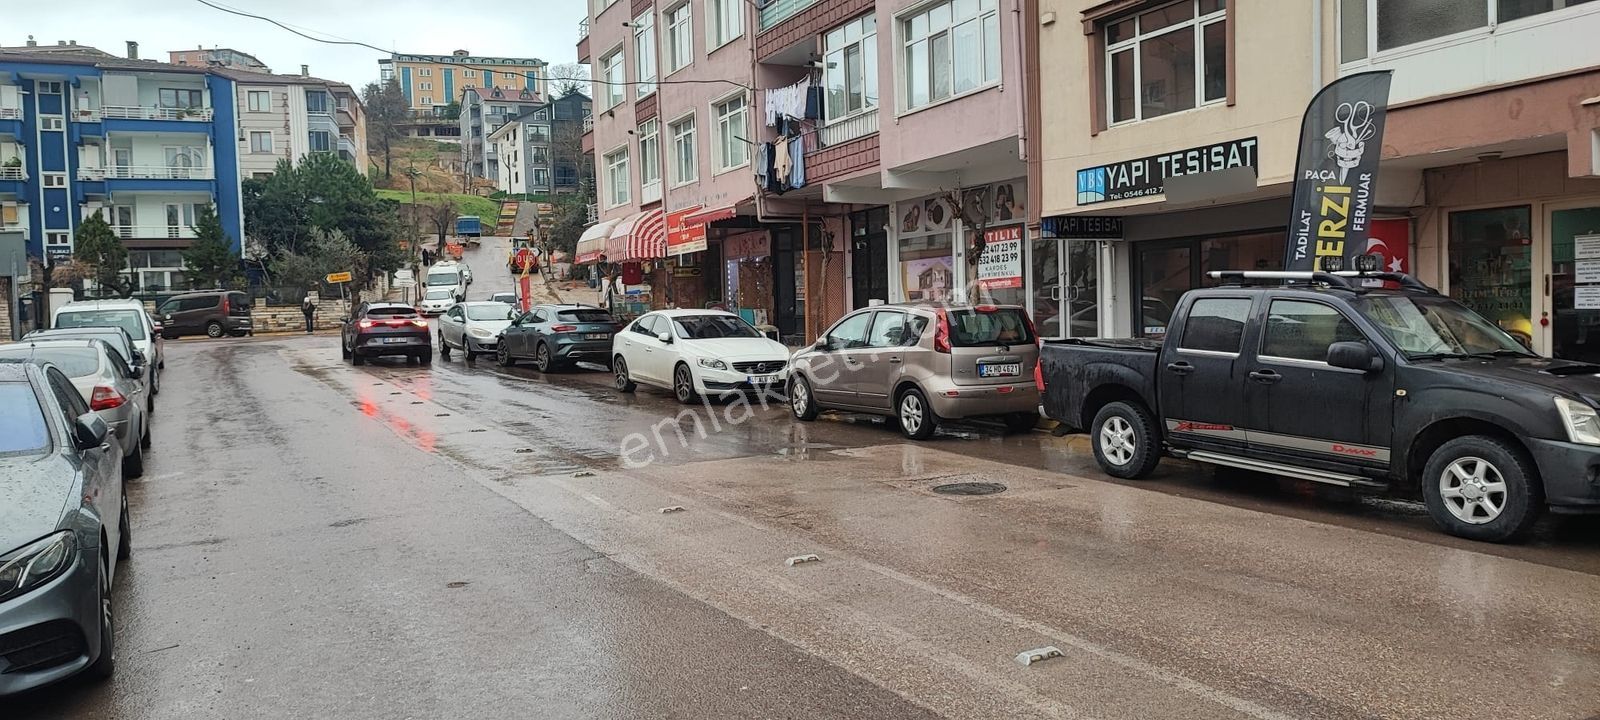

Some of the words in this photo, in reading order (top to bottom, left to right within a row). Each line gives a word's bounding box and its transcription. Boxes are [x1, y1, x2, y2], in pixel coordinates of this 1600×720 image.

[1078, 167, 1105, 191] VBS
[1106, 160, 1150, 190] YAPI
[1305, 170, 1336, 182] PAÇA
[1123, 189, 1143, 199] 0546
[1144, 187, 1158, 195] 412
[1353, 173, 1371, 231] FERMUAR
[1057, 217, 1079, 233] YAPI
[987, 228, 1018, 241] TILIK
[1295, 209, 1312, 260] TADİLAT
[990, 244, 1000, 253] 417
[1001, 243, 1009, 252] 23
[1009, 241, 1018, 251] 99
[517, 254, 534, 263] DUR
[979, 255, 990, 265] 532
[990, 255, 1001, 264] 418
[1001, 253, 1009, 262] 23
[1009, 252, 1019, 261] 99
[985, 364, 993, 373] 34
[1002, 363, 1019, 373] 4621
